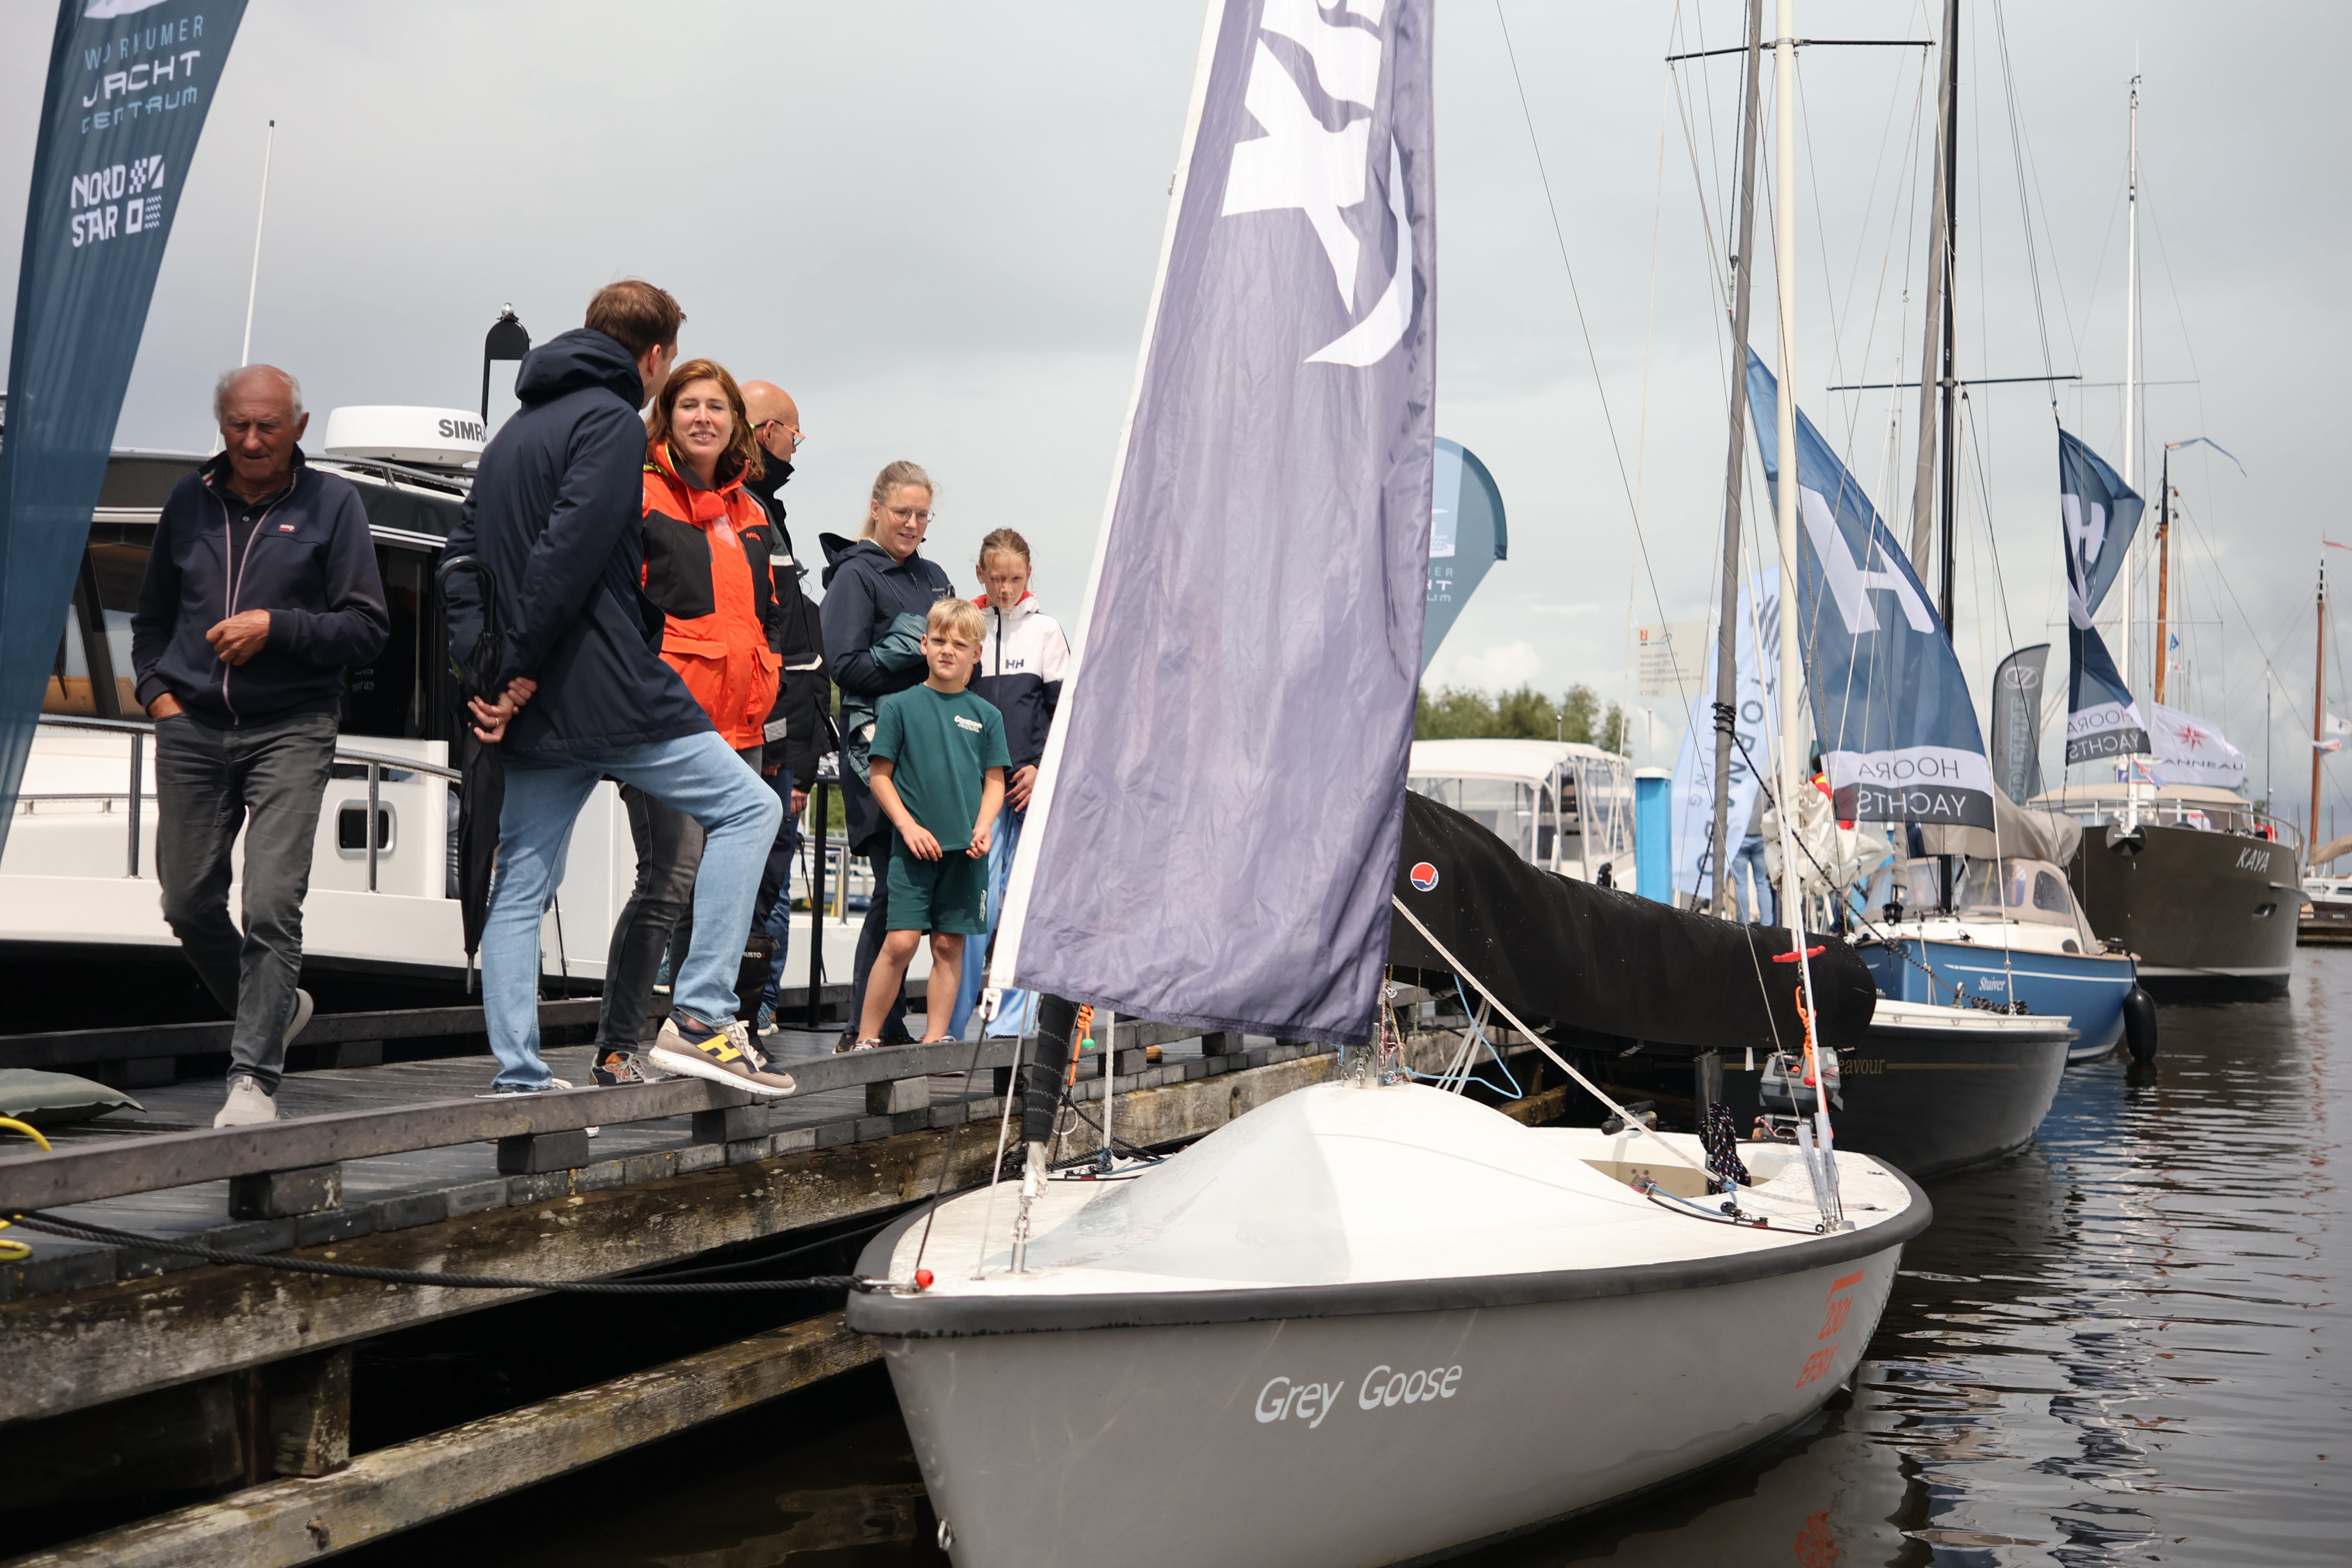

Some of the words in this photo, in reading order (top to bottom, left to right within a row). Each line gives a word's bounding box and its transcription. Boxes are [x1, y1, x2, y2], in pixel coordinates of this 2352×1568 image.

[83, 51, 200, 107] JACHT
[71, 165, 126, 209] NORD
[72, 205, 118, 247] STAR
[1005, 659, 1024, 669] HH
[2162, 758, 2243, 771] ANNEAU
[2236, 846, 2270, 873] KAYA
[1979, 976, 2006, 991] Stuiver
[1838, 1059, 1886, 1075] eavour
[1255, 1376, 1345, 1429] Grey
[1358, 1365, 1463, 1410] Goose
